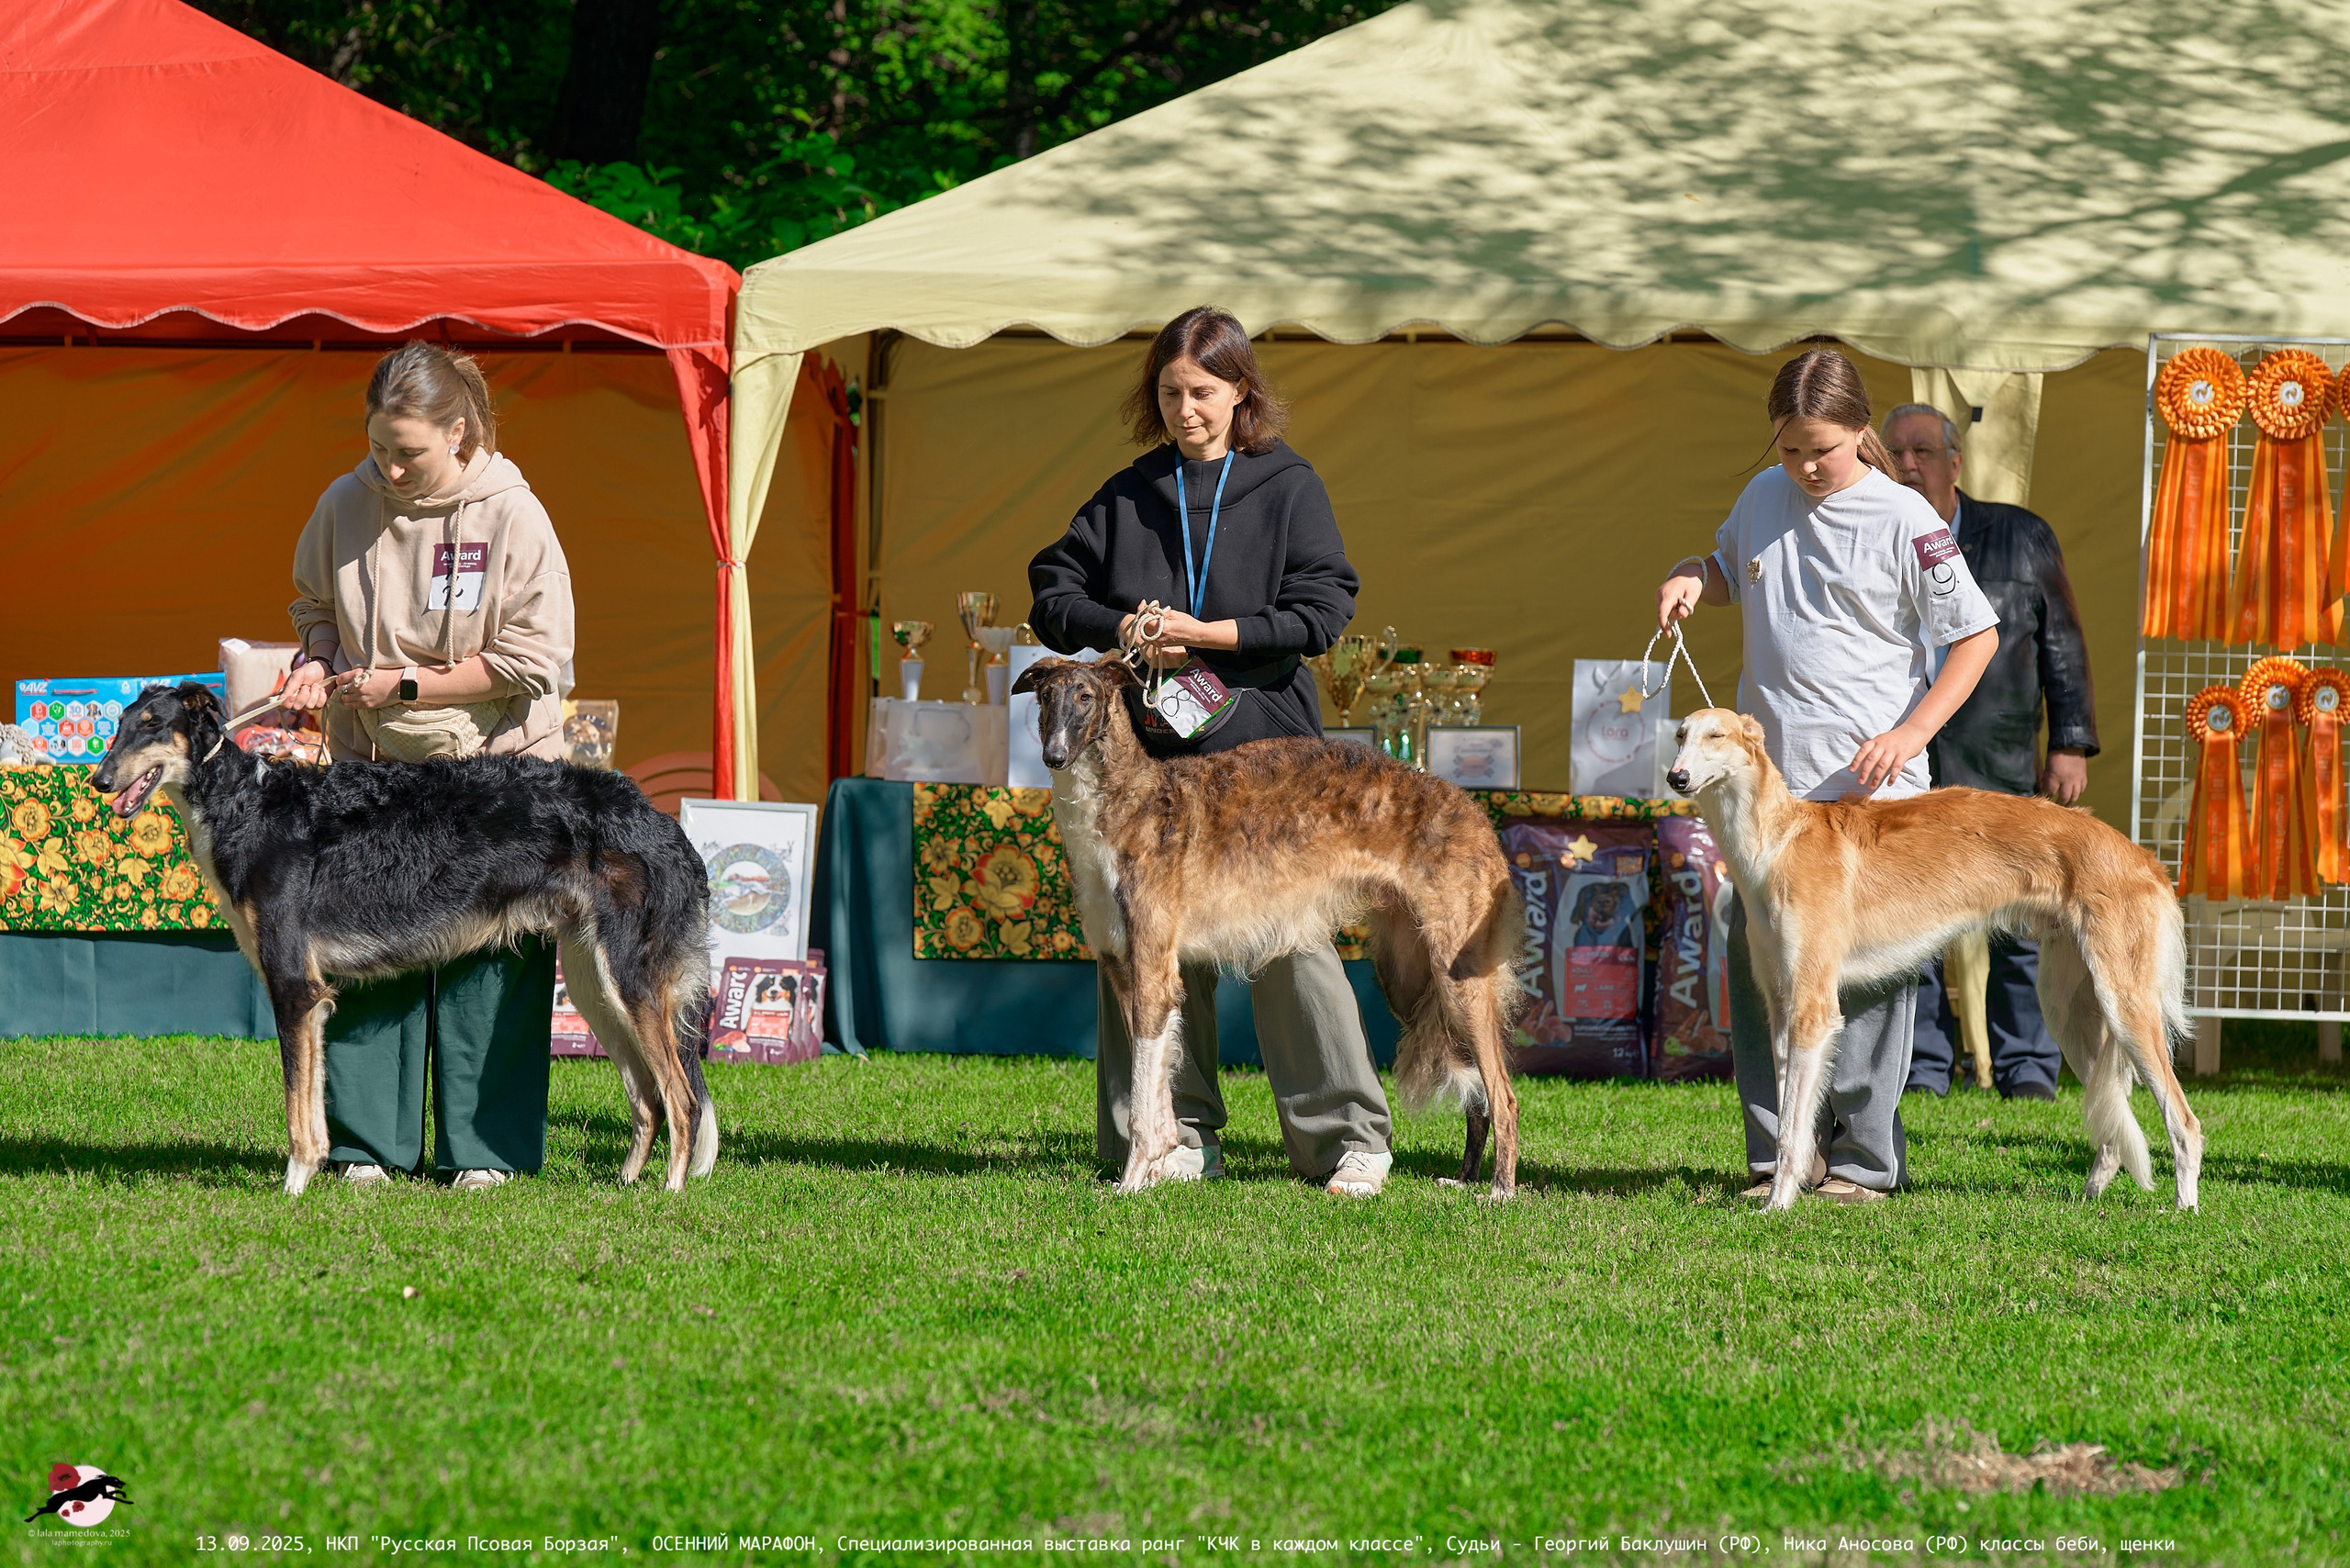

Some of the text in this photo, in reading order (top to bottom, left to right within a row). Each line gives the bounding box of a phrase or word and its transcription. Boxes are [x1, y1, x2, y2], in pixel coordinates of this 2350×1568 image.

[1189, 668, 1223, 702] Award
[1518, 870, 1548, 999] Award
[1670, 871, 1703, 1009] Award
